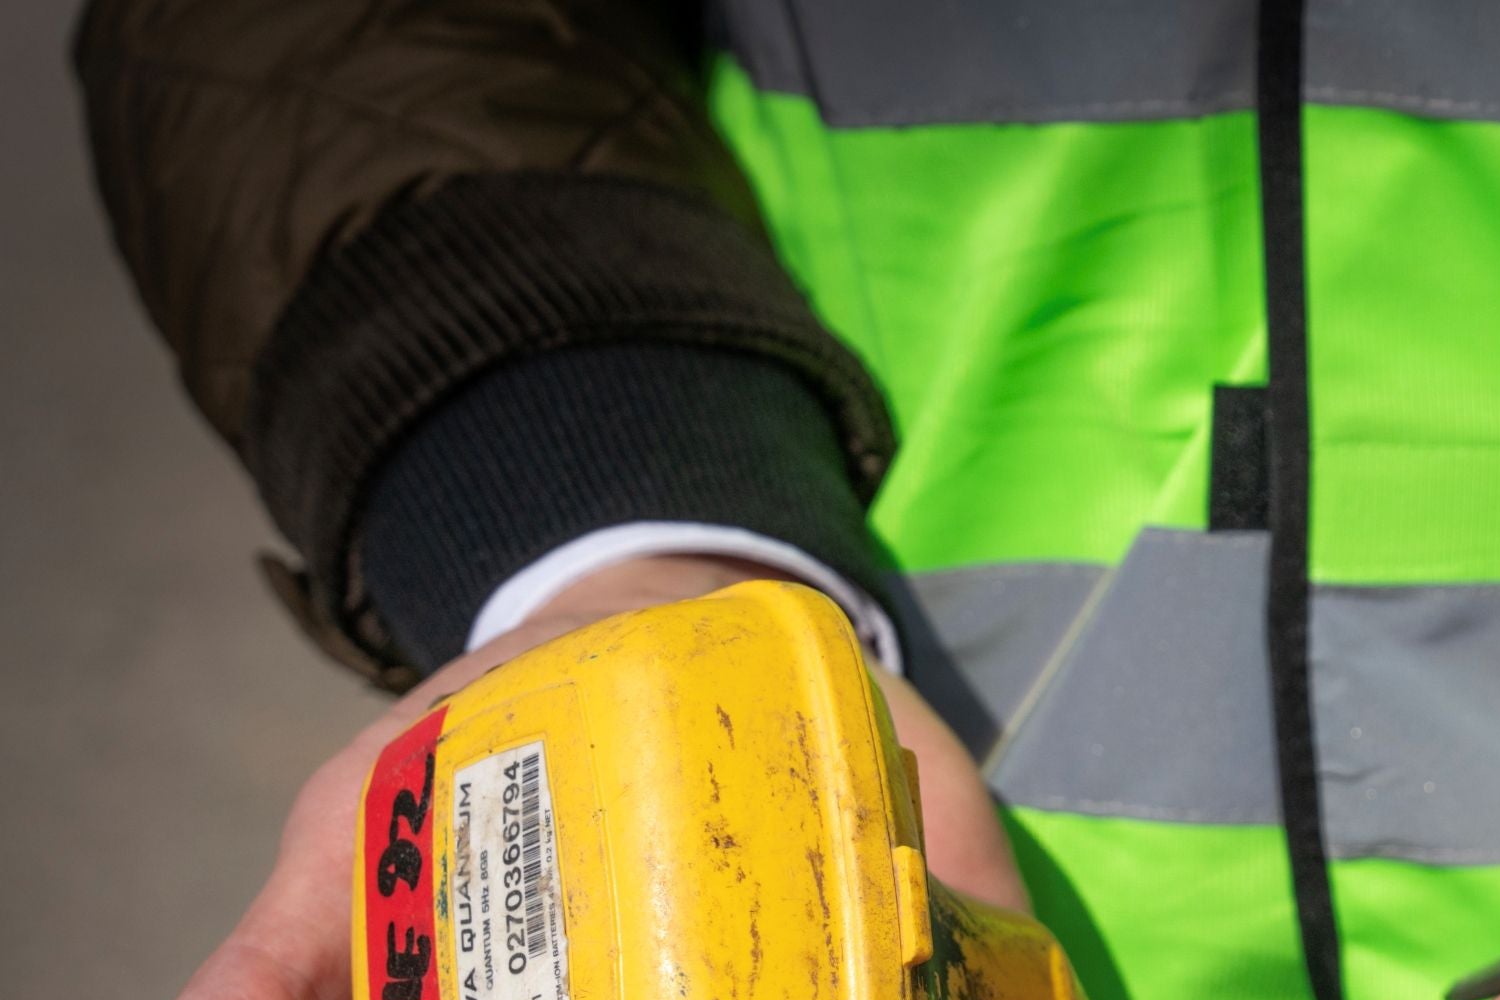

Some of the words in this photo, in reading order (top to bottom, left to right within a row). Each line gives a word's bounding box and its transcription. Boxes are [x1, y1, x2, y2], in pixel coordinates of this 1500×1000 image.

[480, 850, 489, 880] 8GB
[502, 760, 527, 975] 0270366794
[481, 885, 490, 913] 5Hz
[482, 918, 494, 990] QUANTUM
